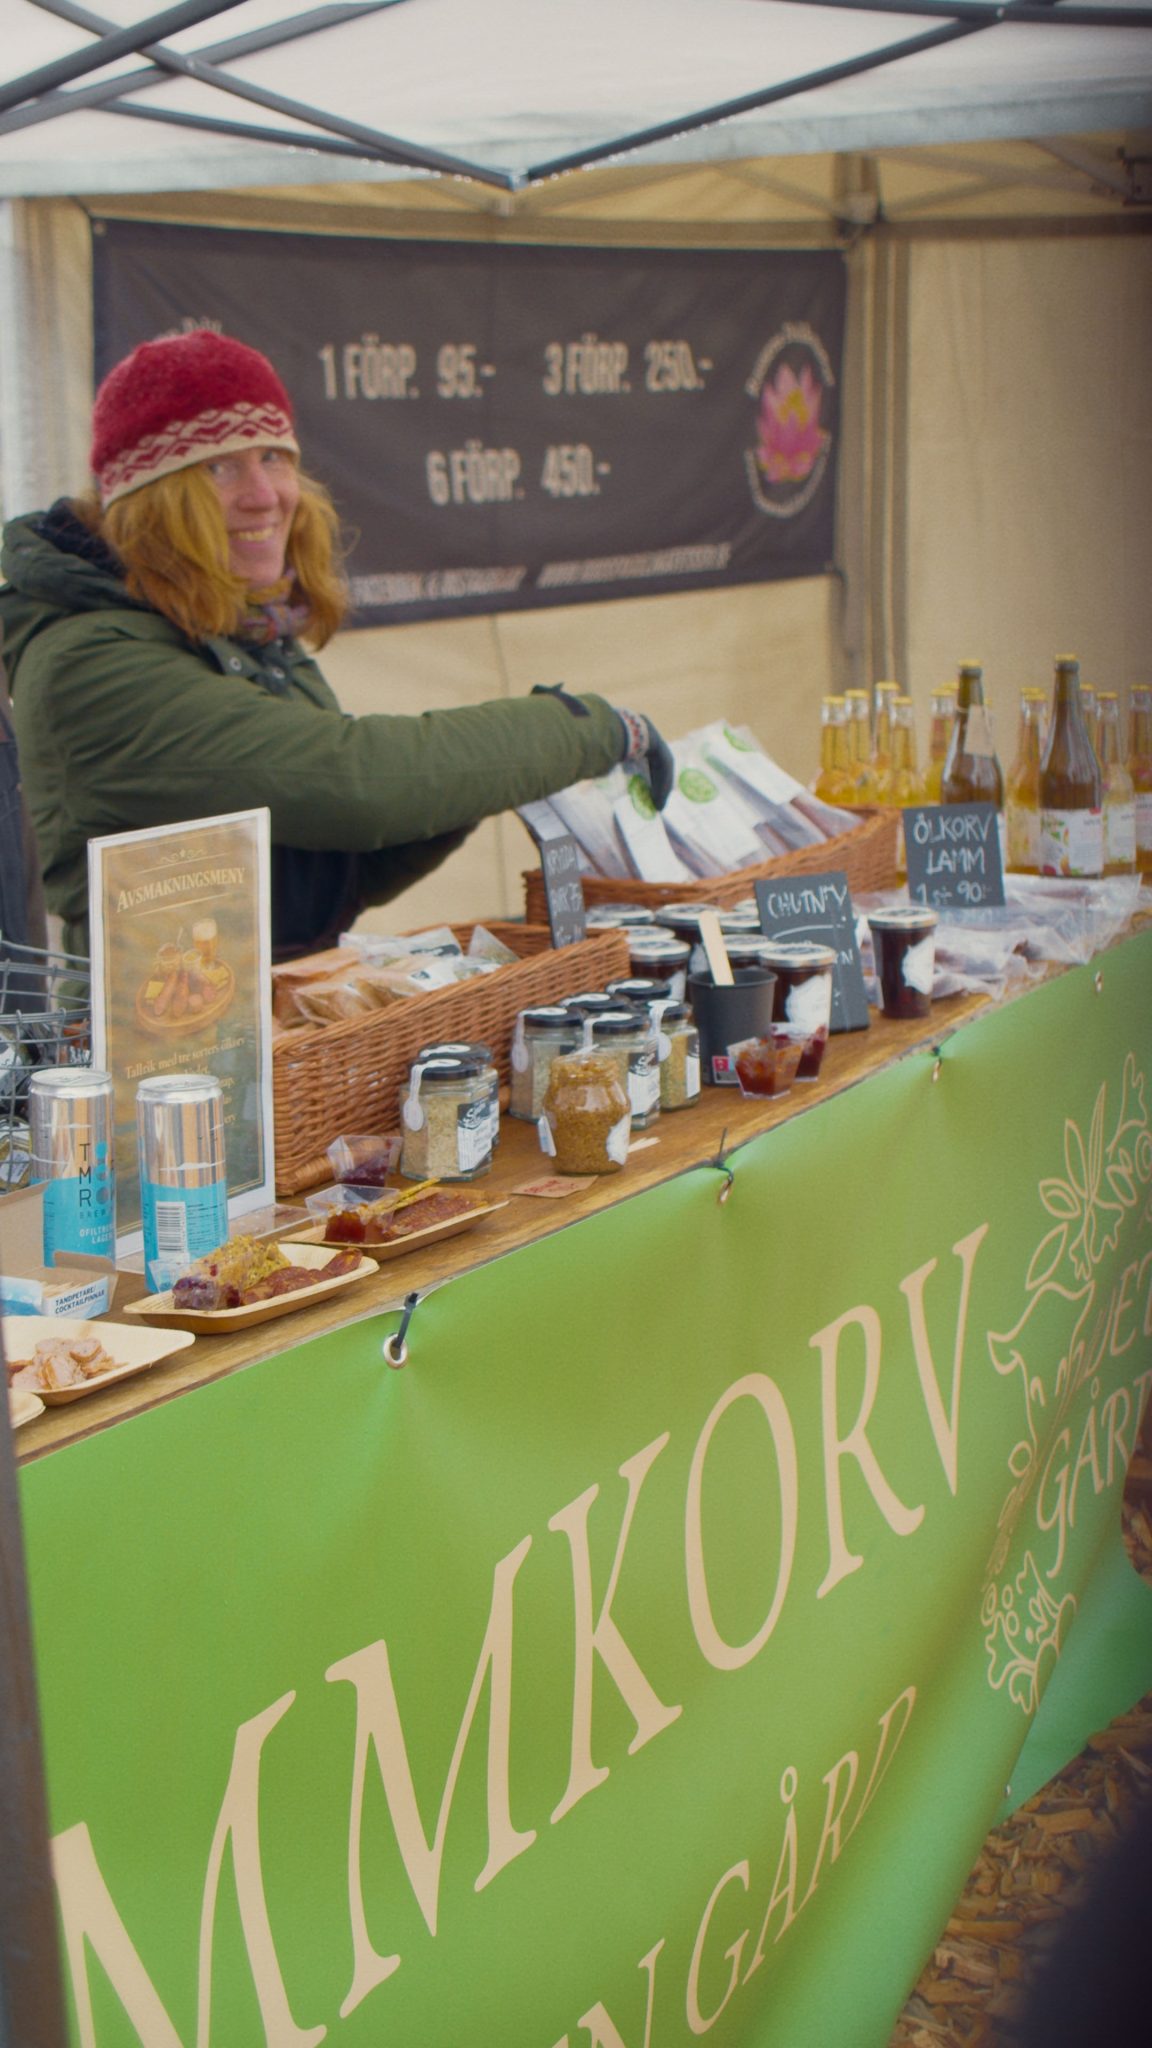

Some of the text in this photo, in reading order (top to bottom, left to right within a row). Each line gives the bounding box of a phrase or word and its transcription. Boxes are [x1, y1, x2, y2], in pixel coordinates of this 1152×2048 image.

[319, 333, 497, 400] 1 FÖRP. 95.-
[542, 342, 564, 396] 3
[565, 332, 632, 395] FÖRP.
[644, 339, 713, 392] 250.-
[425, 438, 611, 506] 6 FÖRP. 450.-
[925, 846, 986, 876] LAMM
[117, 867, 246, 913] AVSMAKNINGSMENY
[158, 1052, 178, 1069] med
